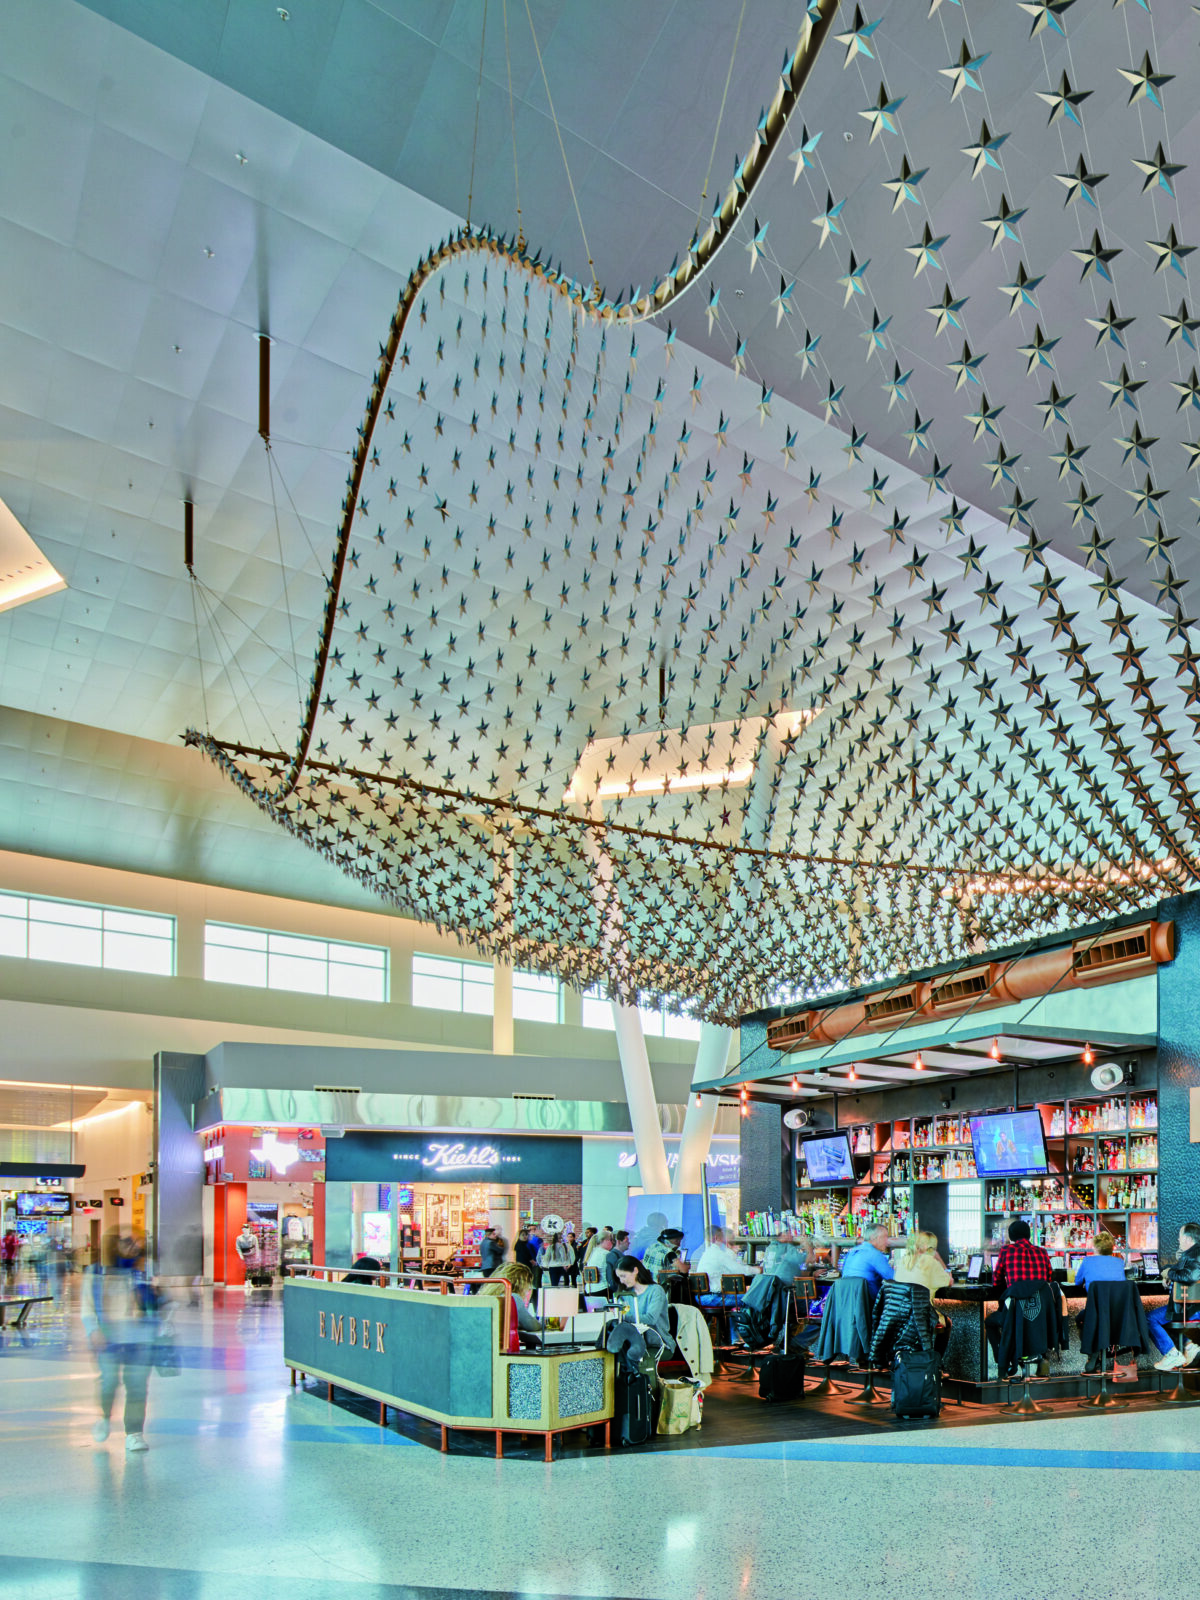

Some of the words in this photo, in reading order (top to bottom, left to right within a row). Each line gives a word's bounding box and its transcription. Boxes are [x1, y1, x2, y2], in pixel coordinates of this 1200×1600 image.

[393, 1153, 420, 1161] SINCE
[422, 1143, 499, 1168] Kiehl's
[37, 1177, 59, 1185] C14
[319, 1310, 386, 1353] EMBER
